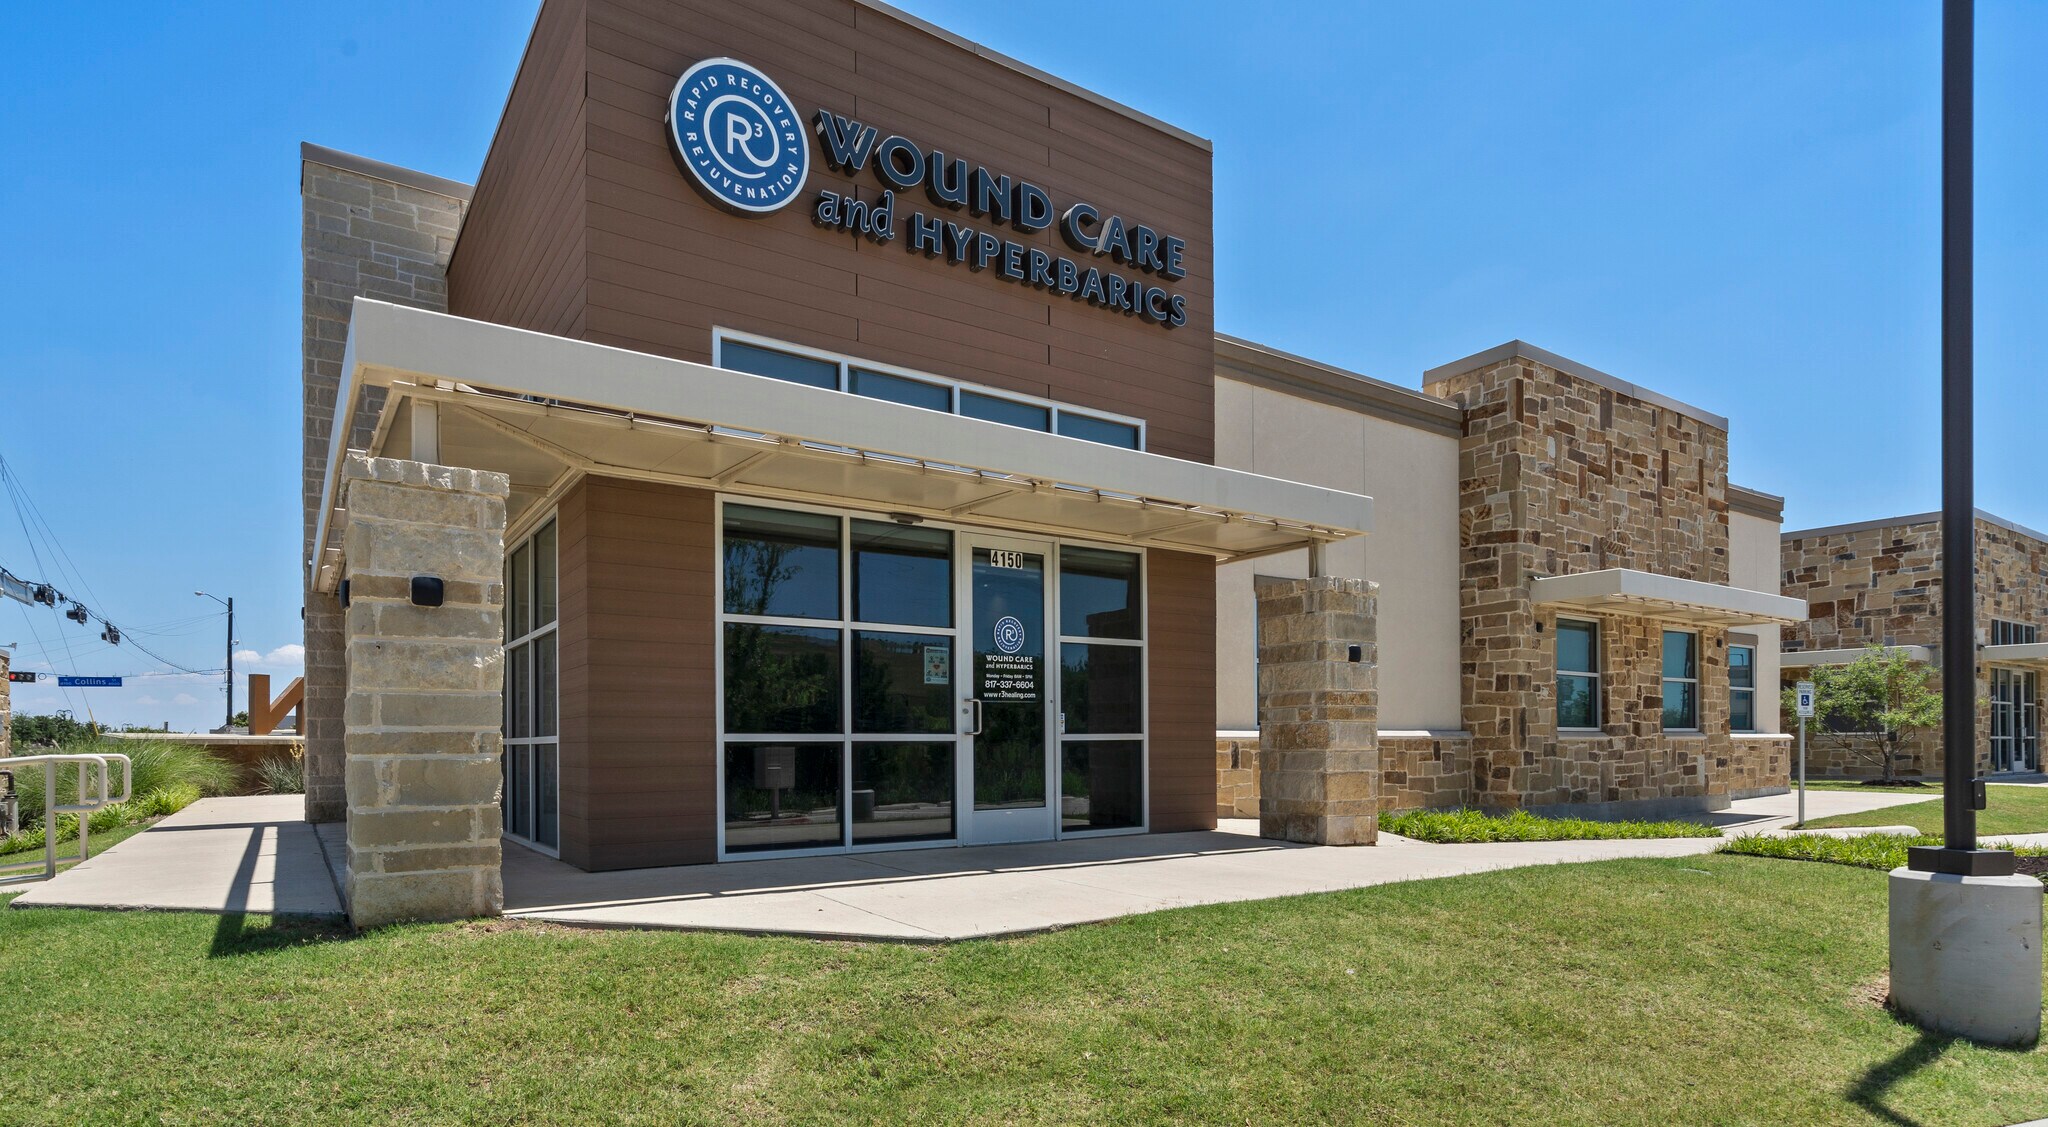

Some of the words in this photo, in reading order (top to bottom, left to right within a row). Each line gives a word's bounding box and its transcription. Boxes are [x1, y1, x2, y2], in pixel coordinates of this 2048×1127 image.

[684, 75, 718, 122] RAPID
[727, 74, 798, 155] RECOVERY
[686, 131, 799, 199] REJUVENATION
[817, 108, 1054, 229] WOUND
[1065, 203, 1187, 279] CARE
[816, 189, 896, 240] and
[913, 211, 1188, 327] HYPERBARICS
[991, 550, 1022, 569] 4150
[984, 680, 1035, 689] 817-337-6604
